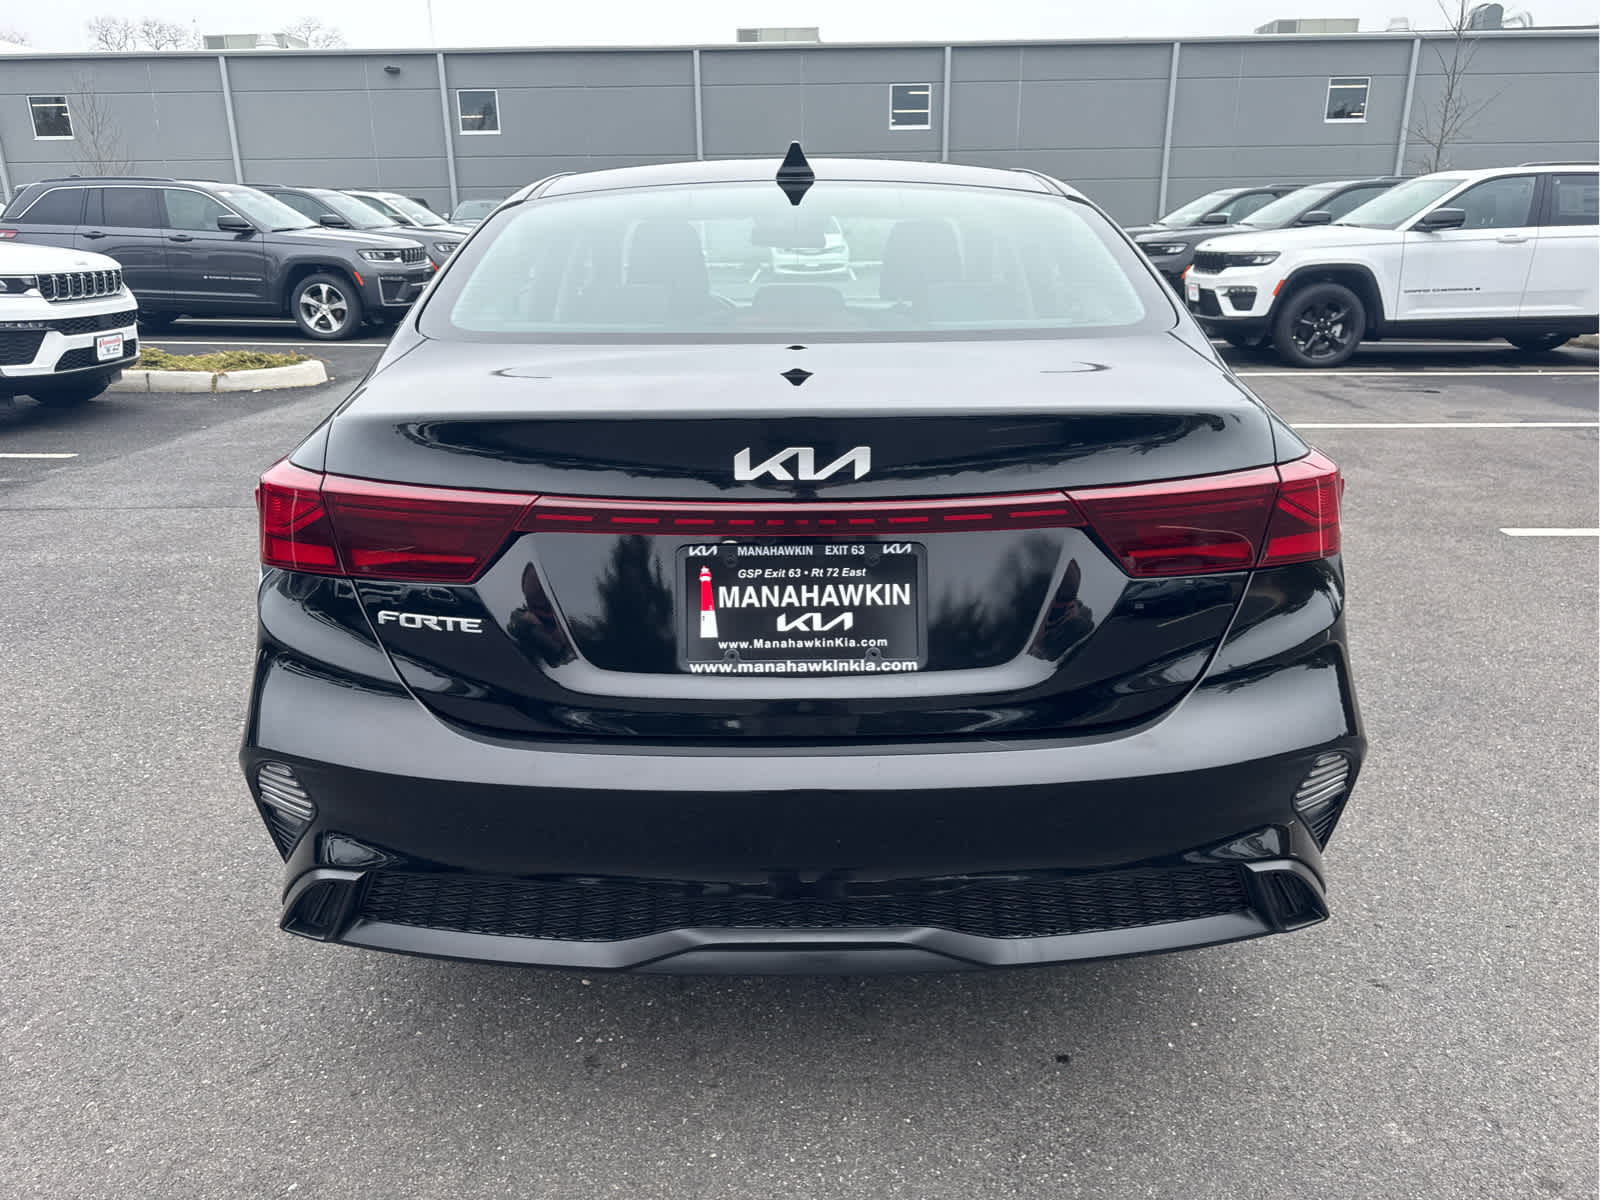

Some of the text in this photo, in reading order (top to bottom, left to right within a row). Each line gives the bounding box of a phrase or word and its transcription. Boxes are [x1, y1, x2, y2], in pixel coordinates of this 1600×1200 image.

[737, 544, 865, 557] MANAHAWKIN EXIT 63
[737, 567, 867, 579] GSP Exit 63 Rt 72 East
[718, 583, 911, 609] MANAHAWKIN
[377, 609, 483, 634] FORTE
[718, 637, 888, 650] www.ManahawkinKia.com
[689, 659, 918, 673] www.manahawkinkia.com
